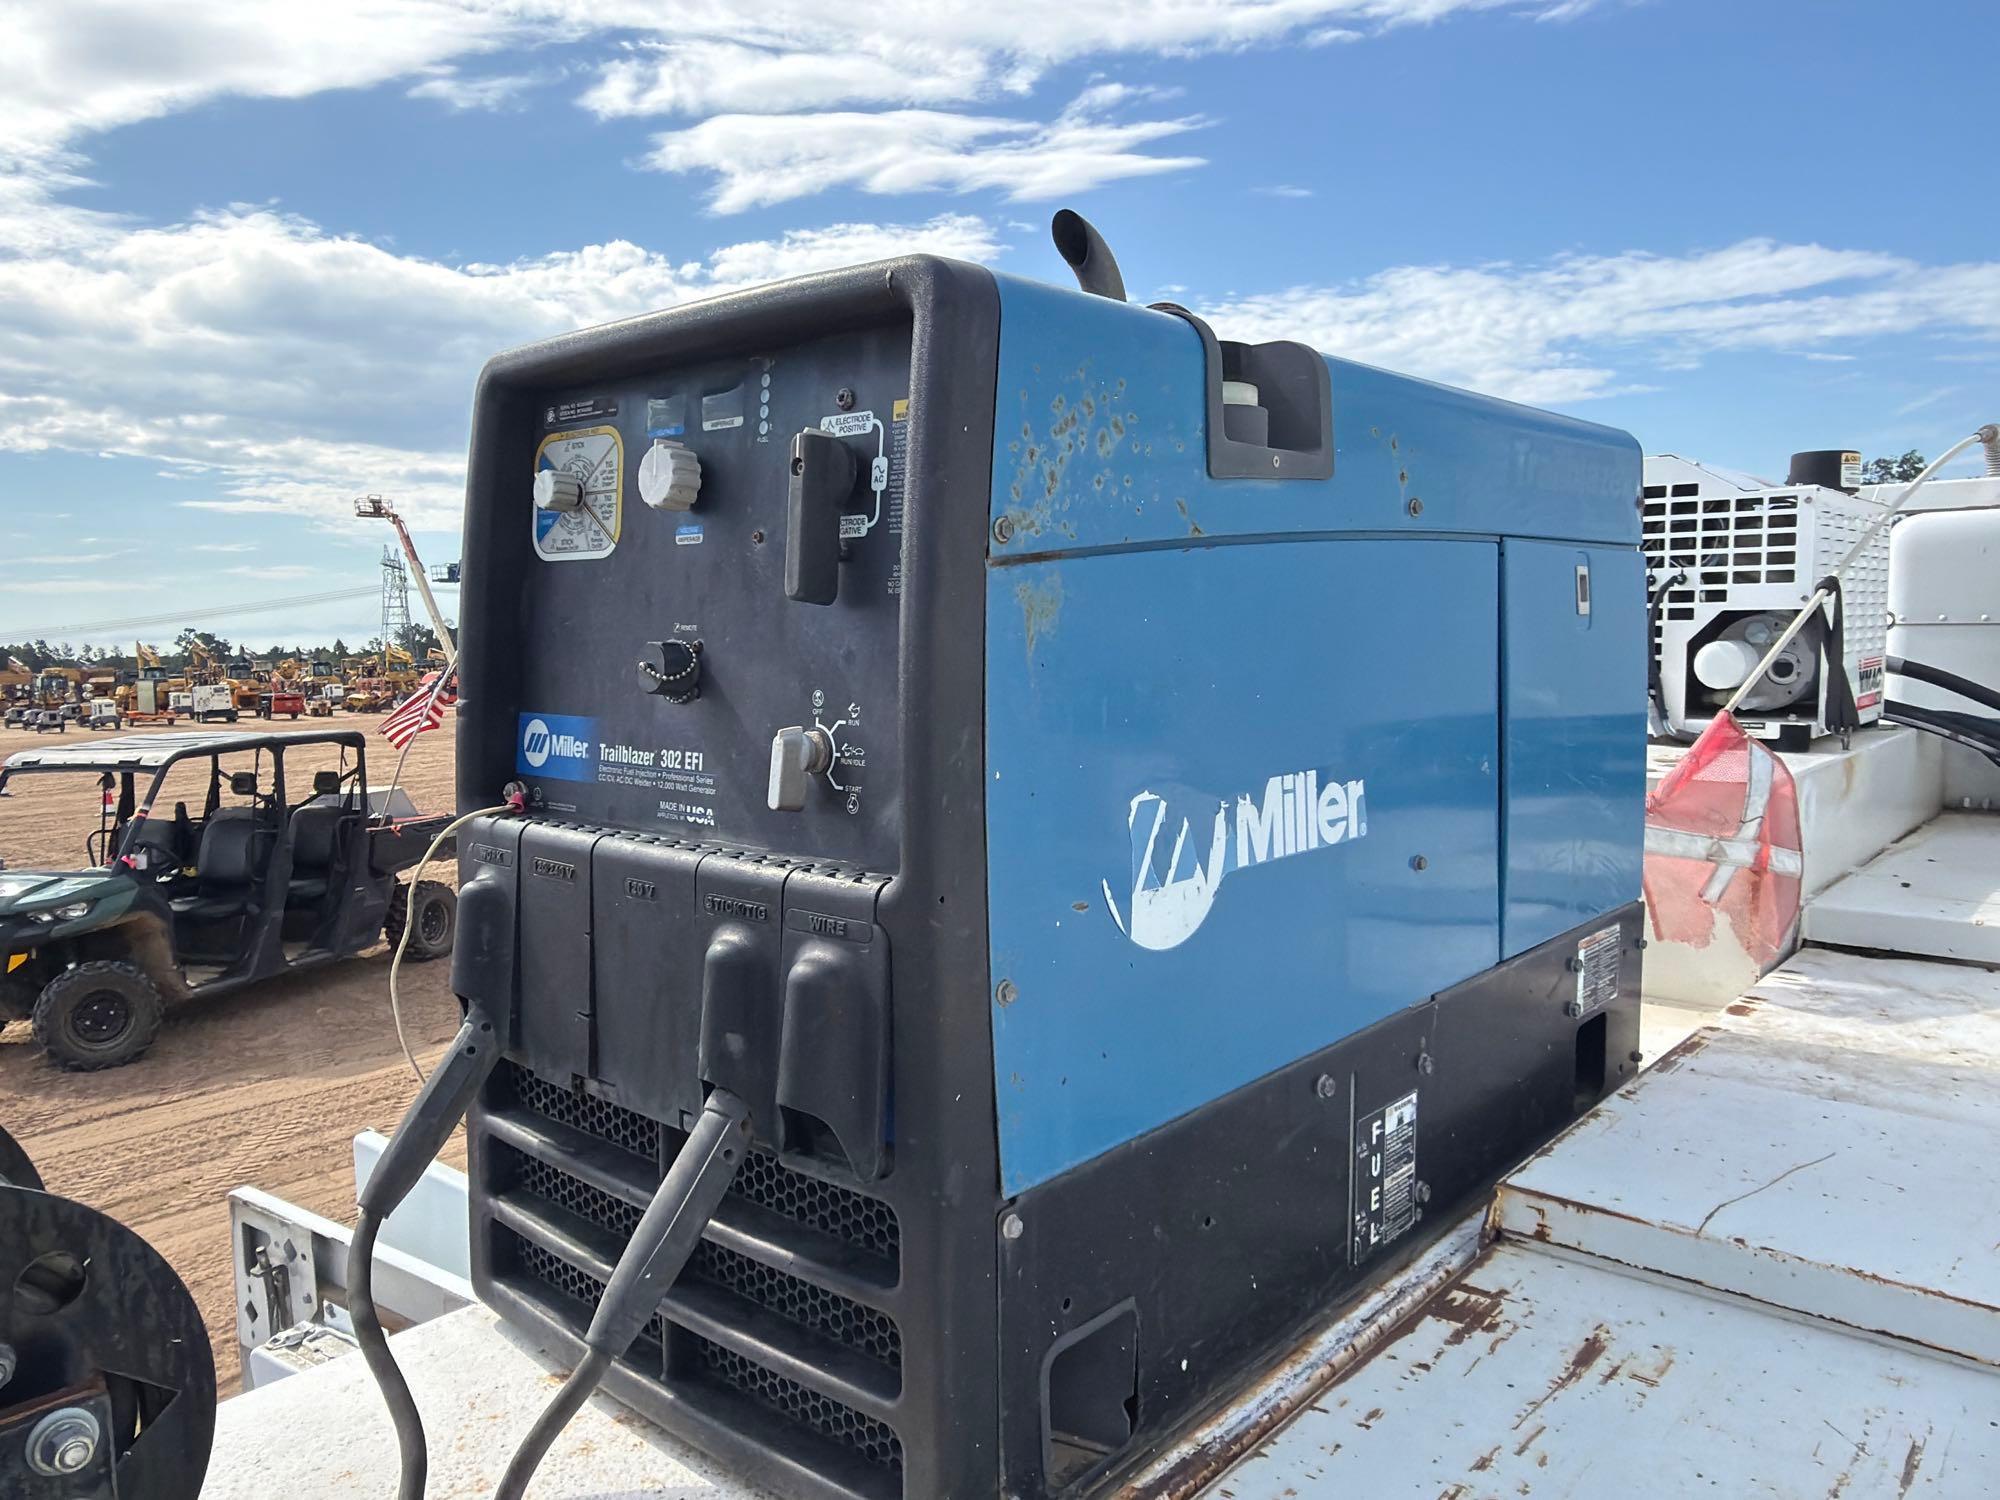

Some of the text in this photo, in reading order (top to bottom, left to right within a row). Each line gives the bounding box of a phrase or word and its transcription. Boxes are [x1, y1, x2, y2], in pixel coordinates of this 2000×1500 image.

[836, 413, 871, 426] ELECTRODE
[839, 423, 867, 433] POSITIVE
[873, 475, 884, 483] AC
[840, 518, 866, 526] CTRODE
[840, 526, 862, 535] GATIVE
[848, 719, 860, 727] RUN
[551, 734, 588, 759] Miller
[599, 743, 703, 772] Trailblazer 302 EFI
[598, 764, 714, 785] Electronic Fuel Injection Professional Series
[634, 778, 652, 787] Welder
[675, 783, 688, 792] Watt
[688, 784, 716, 795] Generator
[845, 785, 862, 793] START
[660, 801, 715, 826] MADE IN USA
[1236, 769, 1365, 868] Miller
[480, 849, 505, 864] WORK
[627, 880, 656, 898] 120 V
[808, 915, 848, 937] WIRE
[1370, 1119, 1384, 1245] FUEL
